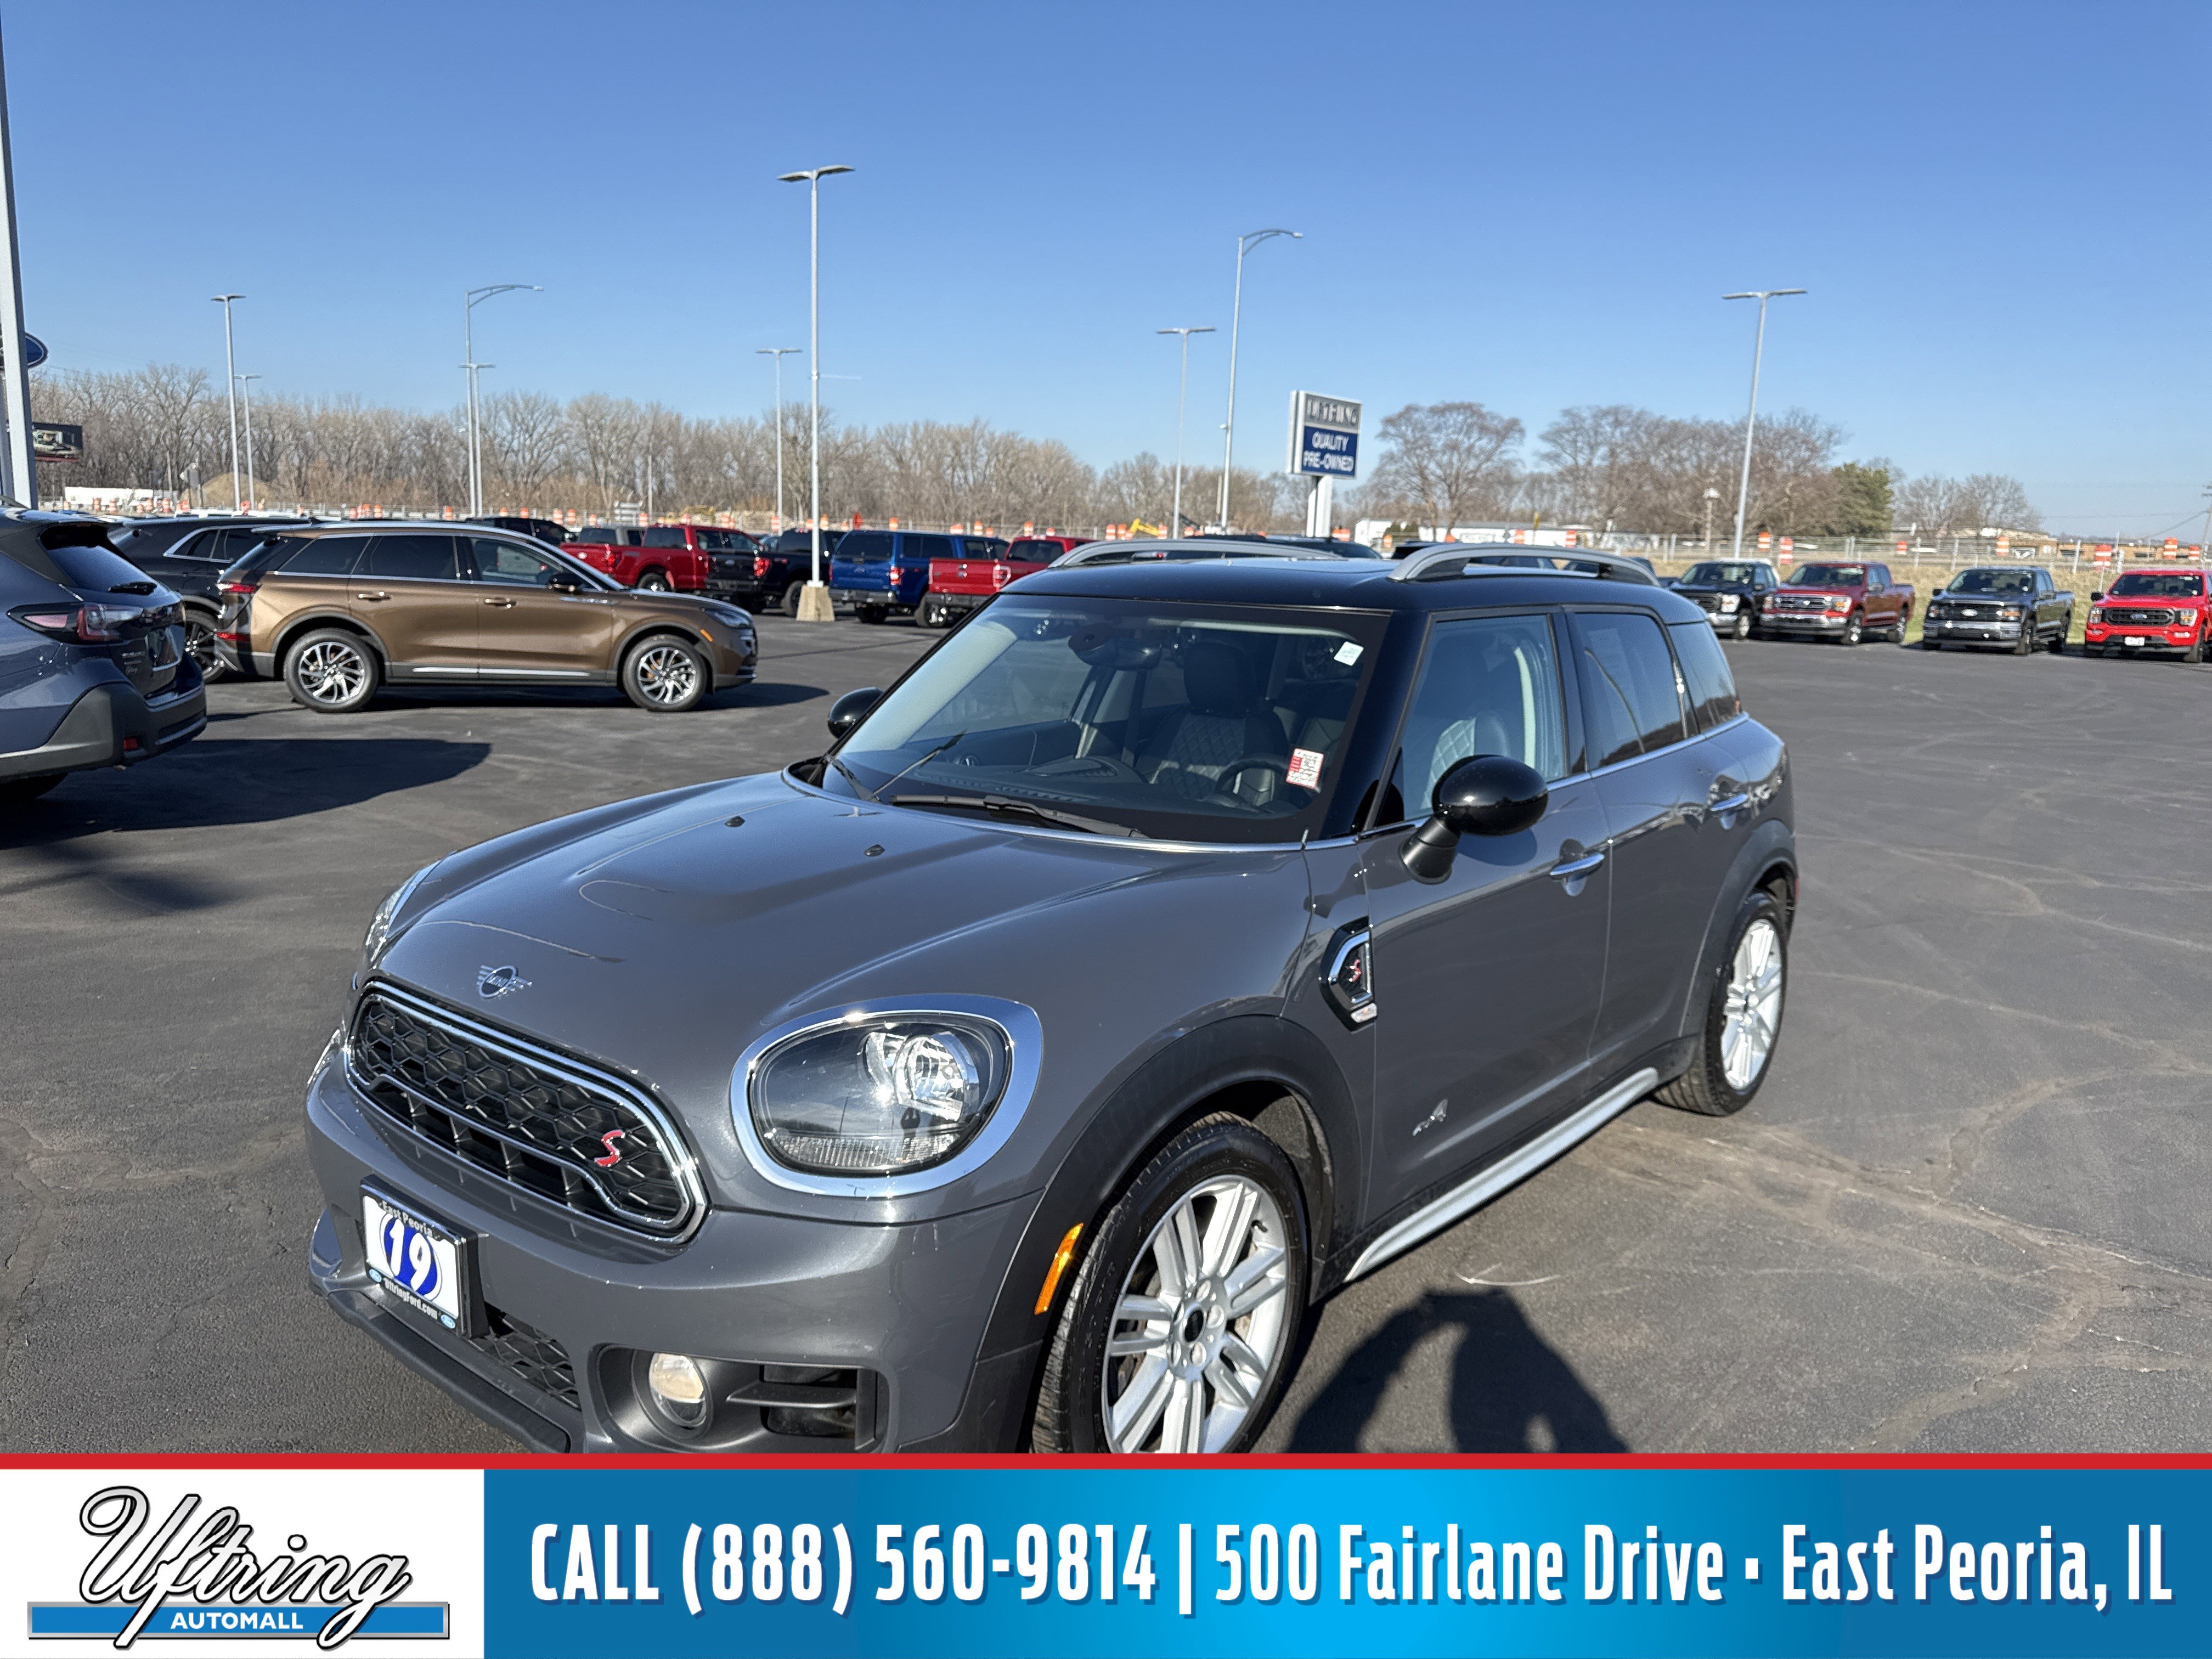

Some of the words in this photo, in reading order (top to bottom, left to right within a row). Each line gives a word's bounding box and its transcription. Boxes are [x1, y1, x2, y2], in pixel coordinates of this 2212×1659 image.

[1311, 431, 1350, 452] QUALITY
[1303, 450, 1355, 472] PRE-OWNED
[593, 1128, 625, 1167] S
[382, 1200, 402, 1221] East
[402, 1211, 433, 1238] Peoria
[389, 1218, 432, 1292] 19
